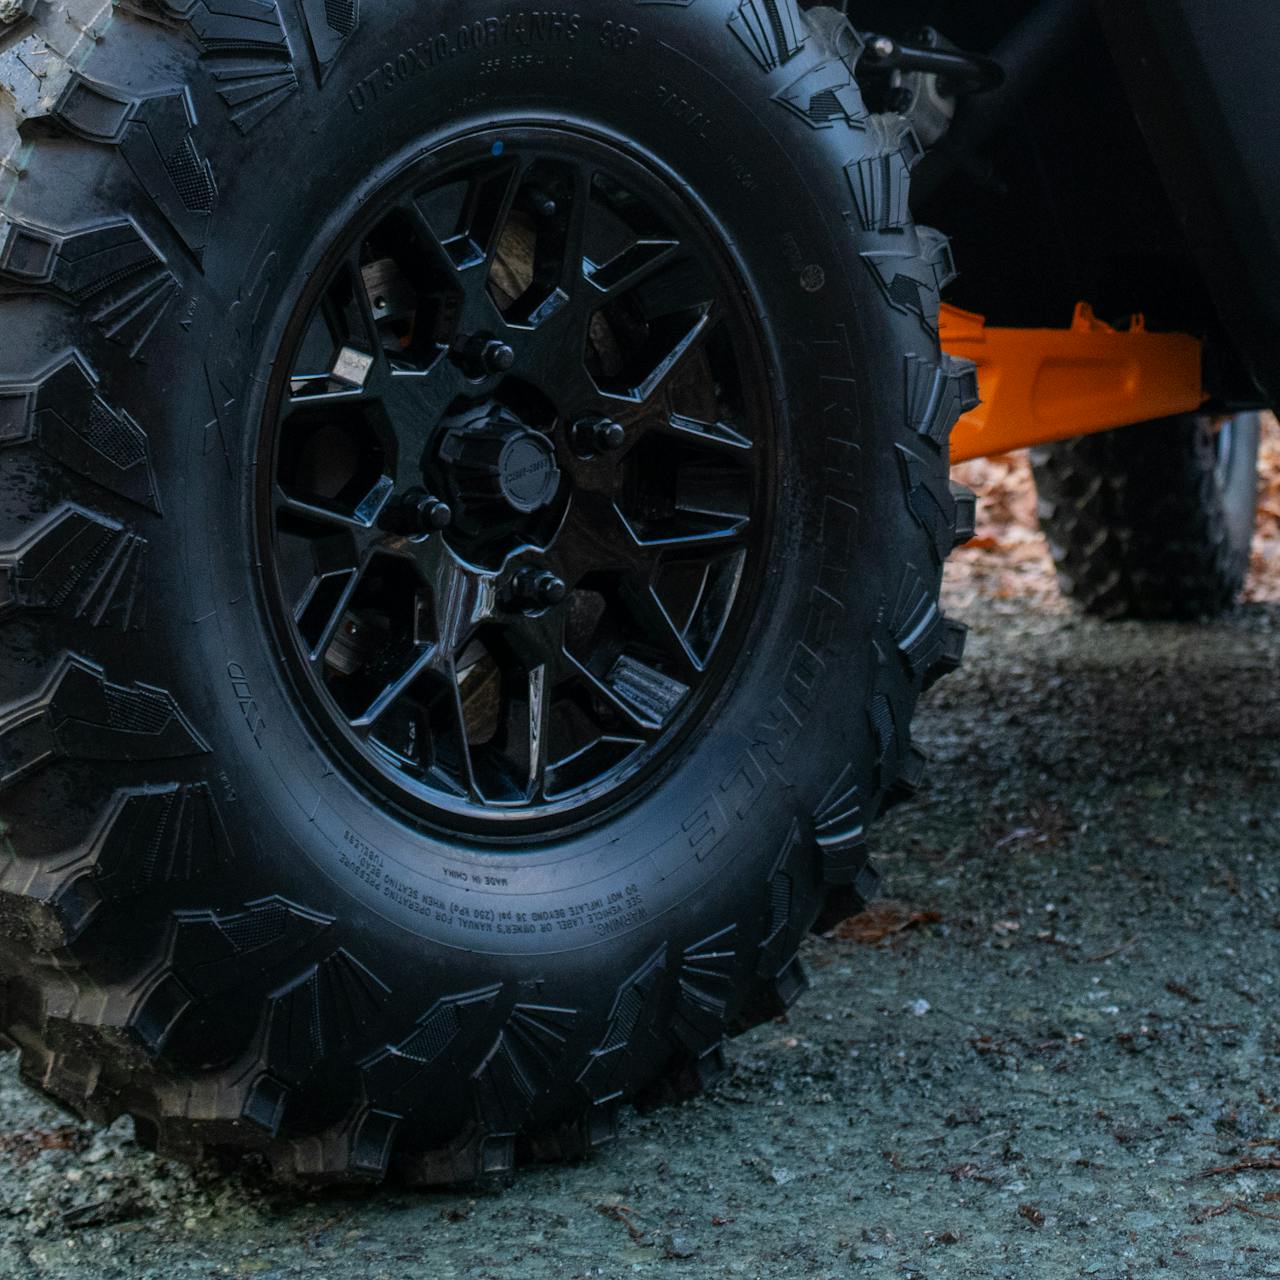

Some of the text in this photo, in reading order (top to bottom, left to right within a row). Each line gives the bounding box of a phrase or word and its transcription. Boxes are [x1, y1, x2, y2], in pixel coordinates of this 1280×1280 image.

[341, 827, 386, 869] TUBELESS
[440, 863, 468, 883] CHINA
[483, 873, 508, 889] MADE
[382, 870, 419, 901] SEATING
[622, 881, 638, 898] DO
[382, 882, 431, 918] OPERATING
[420, 891, 446, 912] WHEN
[566, 896, 604, 917] INFLATE
[604, 888, 623, 906] NOT
[624, 892, 642, 909] SEE
[433, 908, 453, 926] FOR
[530, 907, 565, 922] BEYOND
[585, 901, 623, 924] VEHICLE
[591, 902, 648, 939] WARNING:
[455, 914, 492, 934] MANUAL
[495, 921, 536, 937] OWNER'S
[539, 921, 553, 934] OR
[555, 915, 584, 931] LABEL
